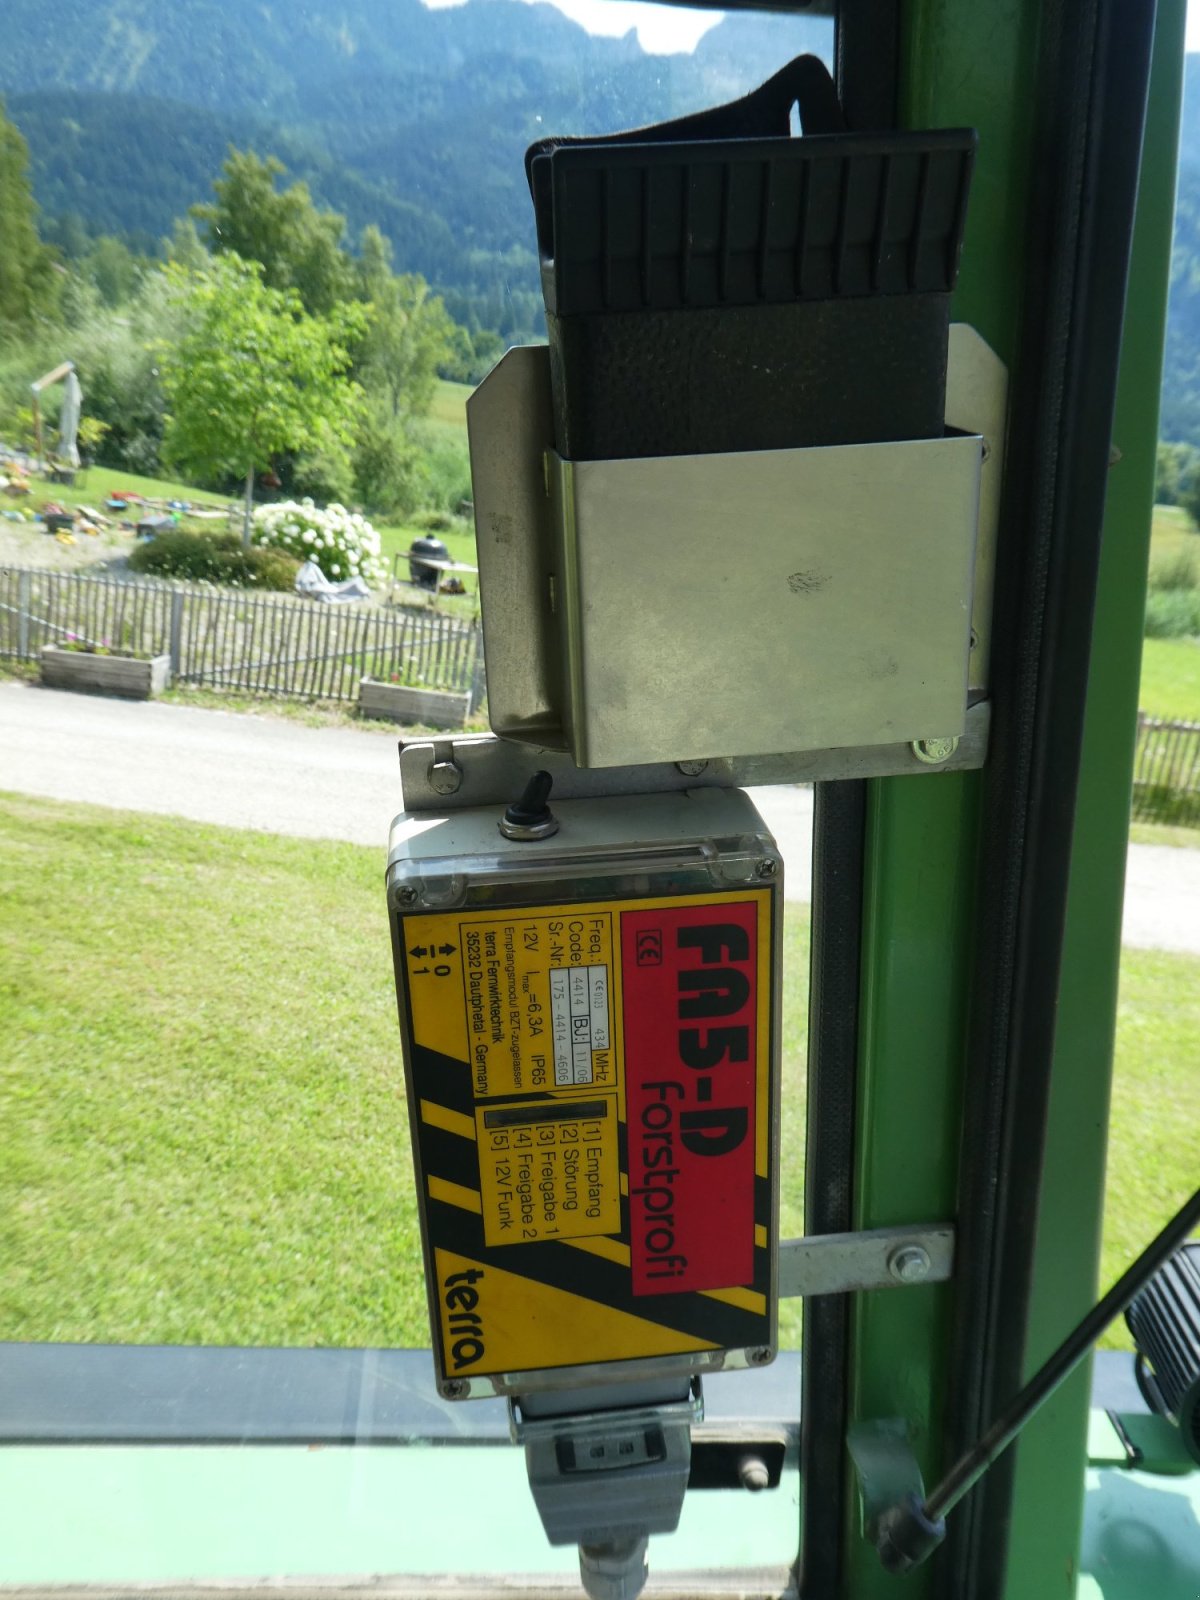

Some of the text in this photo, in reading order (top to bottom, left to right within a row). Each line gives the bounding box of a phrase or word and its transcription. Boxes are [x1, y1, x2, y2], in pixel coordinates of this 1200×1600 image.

[466, 931, 481, 968] 35232
[524, 924, 539, 952] 12V
[548, 921, 564, 967] Sr.-Nr:
[588, 919, 604, 963] Freq.:
[434, 965, 451, 977] 0
[468, 971, 486, 1034] Dautphetal
[485, 931, 505, 1044] terra Fernwirktechnik
[569, 921, 589, 1083] Code: 4414 BJ: 11/06
[504, 926, 522, 1088] Empfangsmodul BZT-zugelassen
[595, 1028, 605, 1048] 434
[475, 1044, 489, 1095] Germany
[531, 1054, 546, 1085] IP65
[596, 1053, 609, 1081] MHz
[677, 923, 750, 1157] FA5-D
[536, 1125, 556, 1146] [3]
[559, 1123, 580, 1210] [2] Störung
[490, 1130, 515, 1230] [5] 12V Funk
[513, 1127, 538, 1239] [4] Freigabe 2
[539, 1151, 558, 1222] Freigabe
[582, 1121, 604, 1218] [1] Empfang
[444, 1268, 485, 1370] terra
